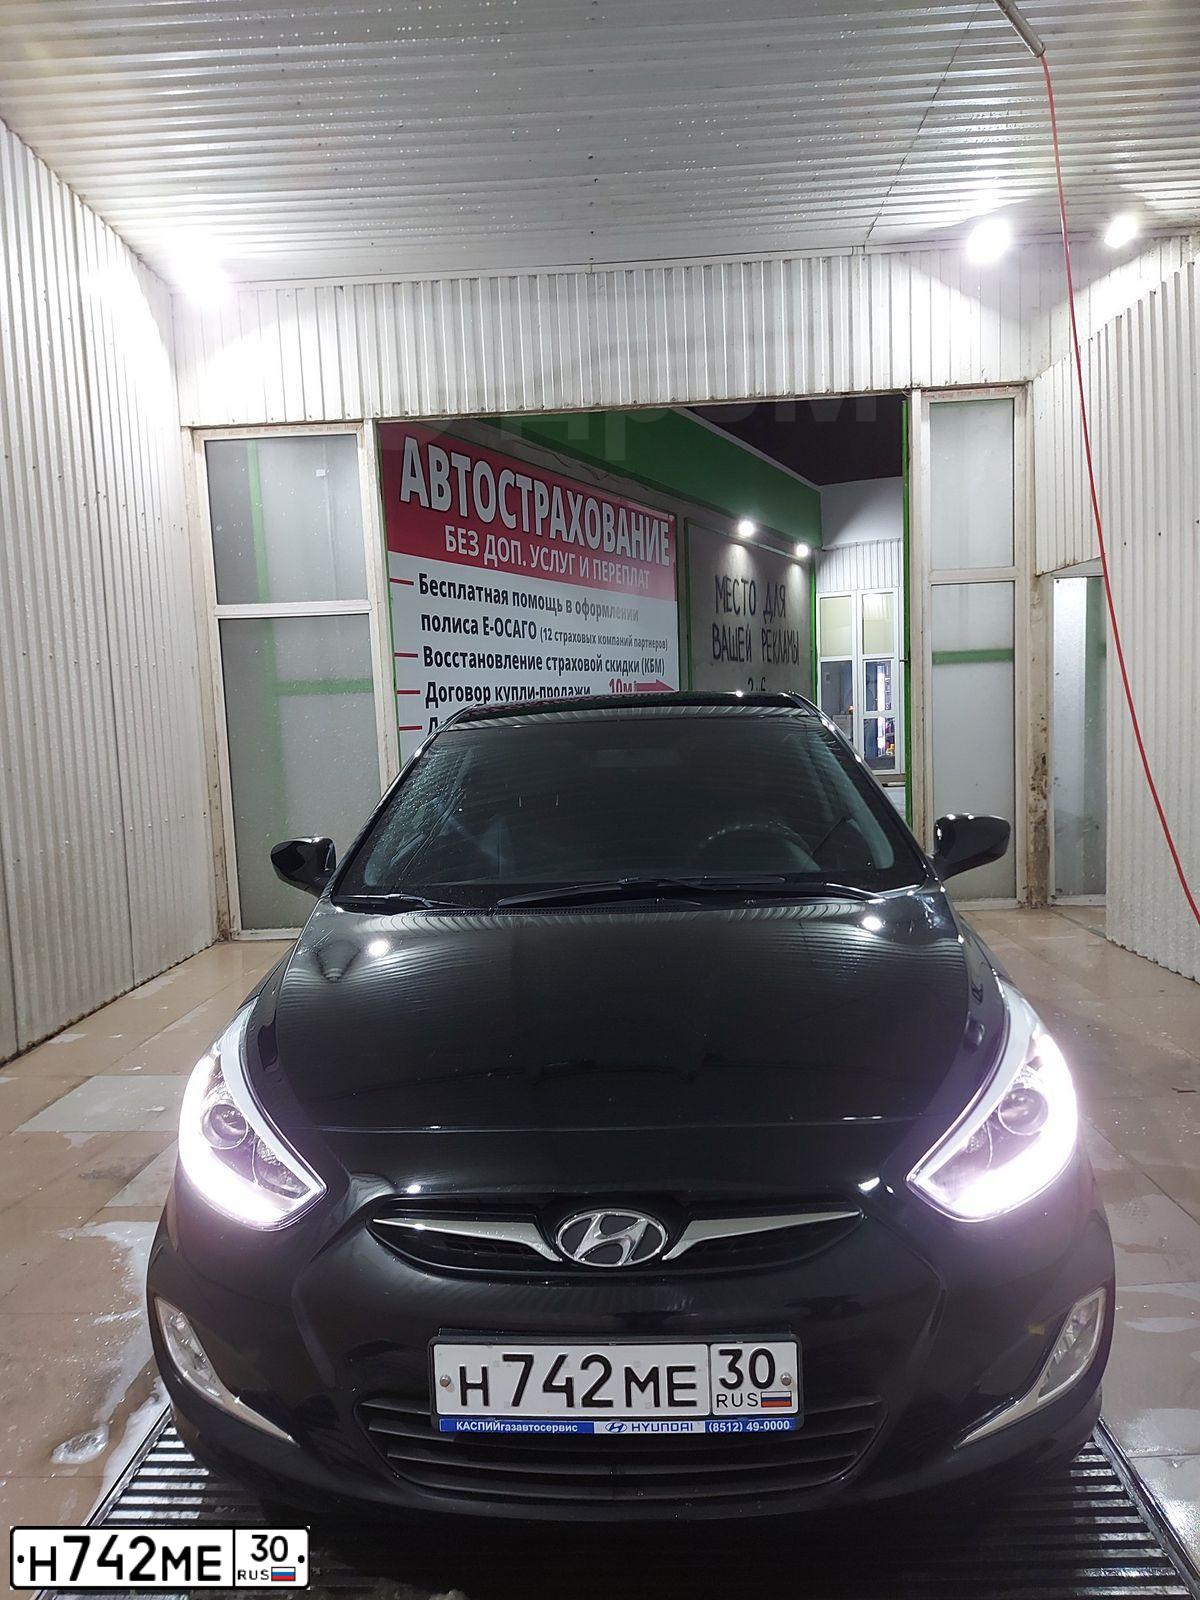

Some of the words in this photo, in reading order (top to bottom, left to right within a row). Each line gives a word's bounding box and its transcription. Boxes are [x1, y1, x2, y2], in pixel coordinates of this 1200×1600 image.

[400, 435, 670, 567] АВТОСТРАХОВАНИЕ
[445, 524, 479, 557] БЕЗ
[484, 533, 527, 567] ДОП.
[529, 543, 576, 575] УСЛУГ
[579, 555, 590, 578] И
[593, 558, 650, 591] ПЕРЕПЛАТ
[418, 572, 509, 606] Бесплатная
[512, 591, 563, 616] помощь
[566, 599, 573, 614] в
[575, 598, 639, 622] оформлении
[715, 575, 756, 616] МЕСТО
[763, 582, 786, 624] ДЛЯ
[421, 613, 479, 636] полиса
[482, 616, 537, 640] Е-ОСАГО
[540, 626, 553, 643] (12
[554, 630, 597, 646] страховых
[598, 634, 634, 649] компаний
[634, 638, 668, 652] партнеров)
[712, 622, 752, 663] ВАШЕЙ
[761, 628, 799, 666] РЕКЛАМЫ
[423, 645, 543, 671] Восстановление
[546, 653, 603, 677] страховой
[605, 658, 640, 677] скидки
[641, 657, 665, 677] (КБМ)
[425, 681, 492, 709] Договор
[495, 684, 591, 703] купли-продажи
[718, 1348, 777, 1390] 30
[716, 1393, 759, 1408] RUS
[631, 1421, 693, 1433] HYUNDAI
[708, 1421, 743, 1433] (8512)
[746, 1419, 790, 1432] 49-0000
